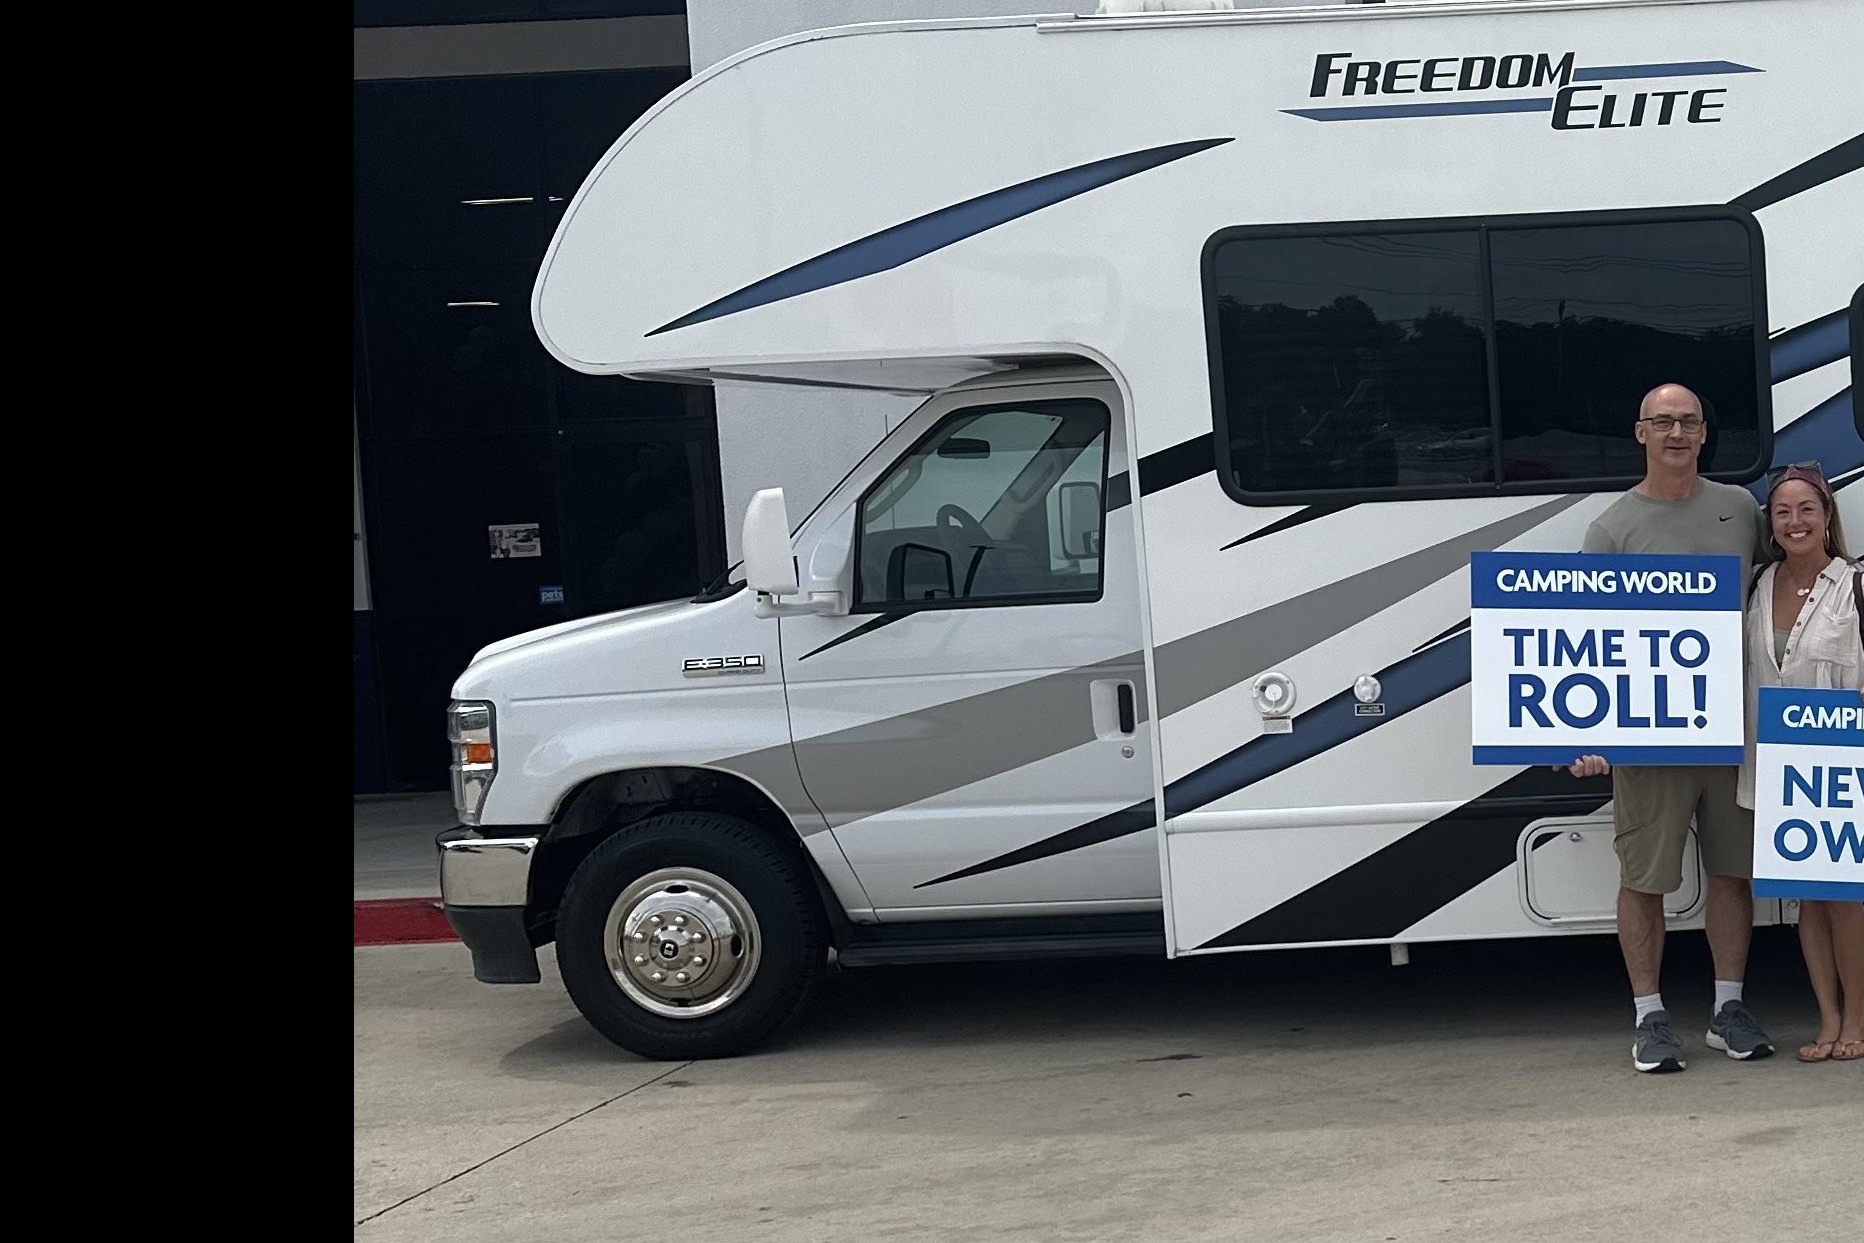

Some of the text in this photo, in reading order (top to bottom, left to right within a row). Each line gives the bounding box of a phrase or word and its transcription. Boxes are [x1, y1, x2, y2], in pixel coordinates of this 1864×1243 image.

[1309, 51, 1576, 98] FREEDOM
[1550, 85, 1728, 131] ELITE
[1496, 569, 1717, 594] CAMPING WORLD
[1503, 628, 1711, 669] TIME TO
[1508, 672, 1708, 730] ROLL!
